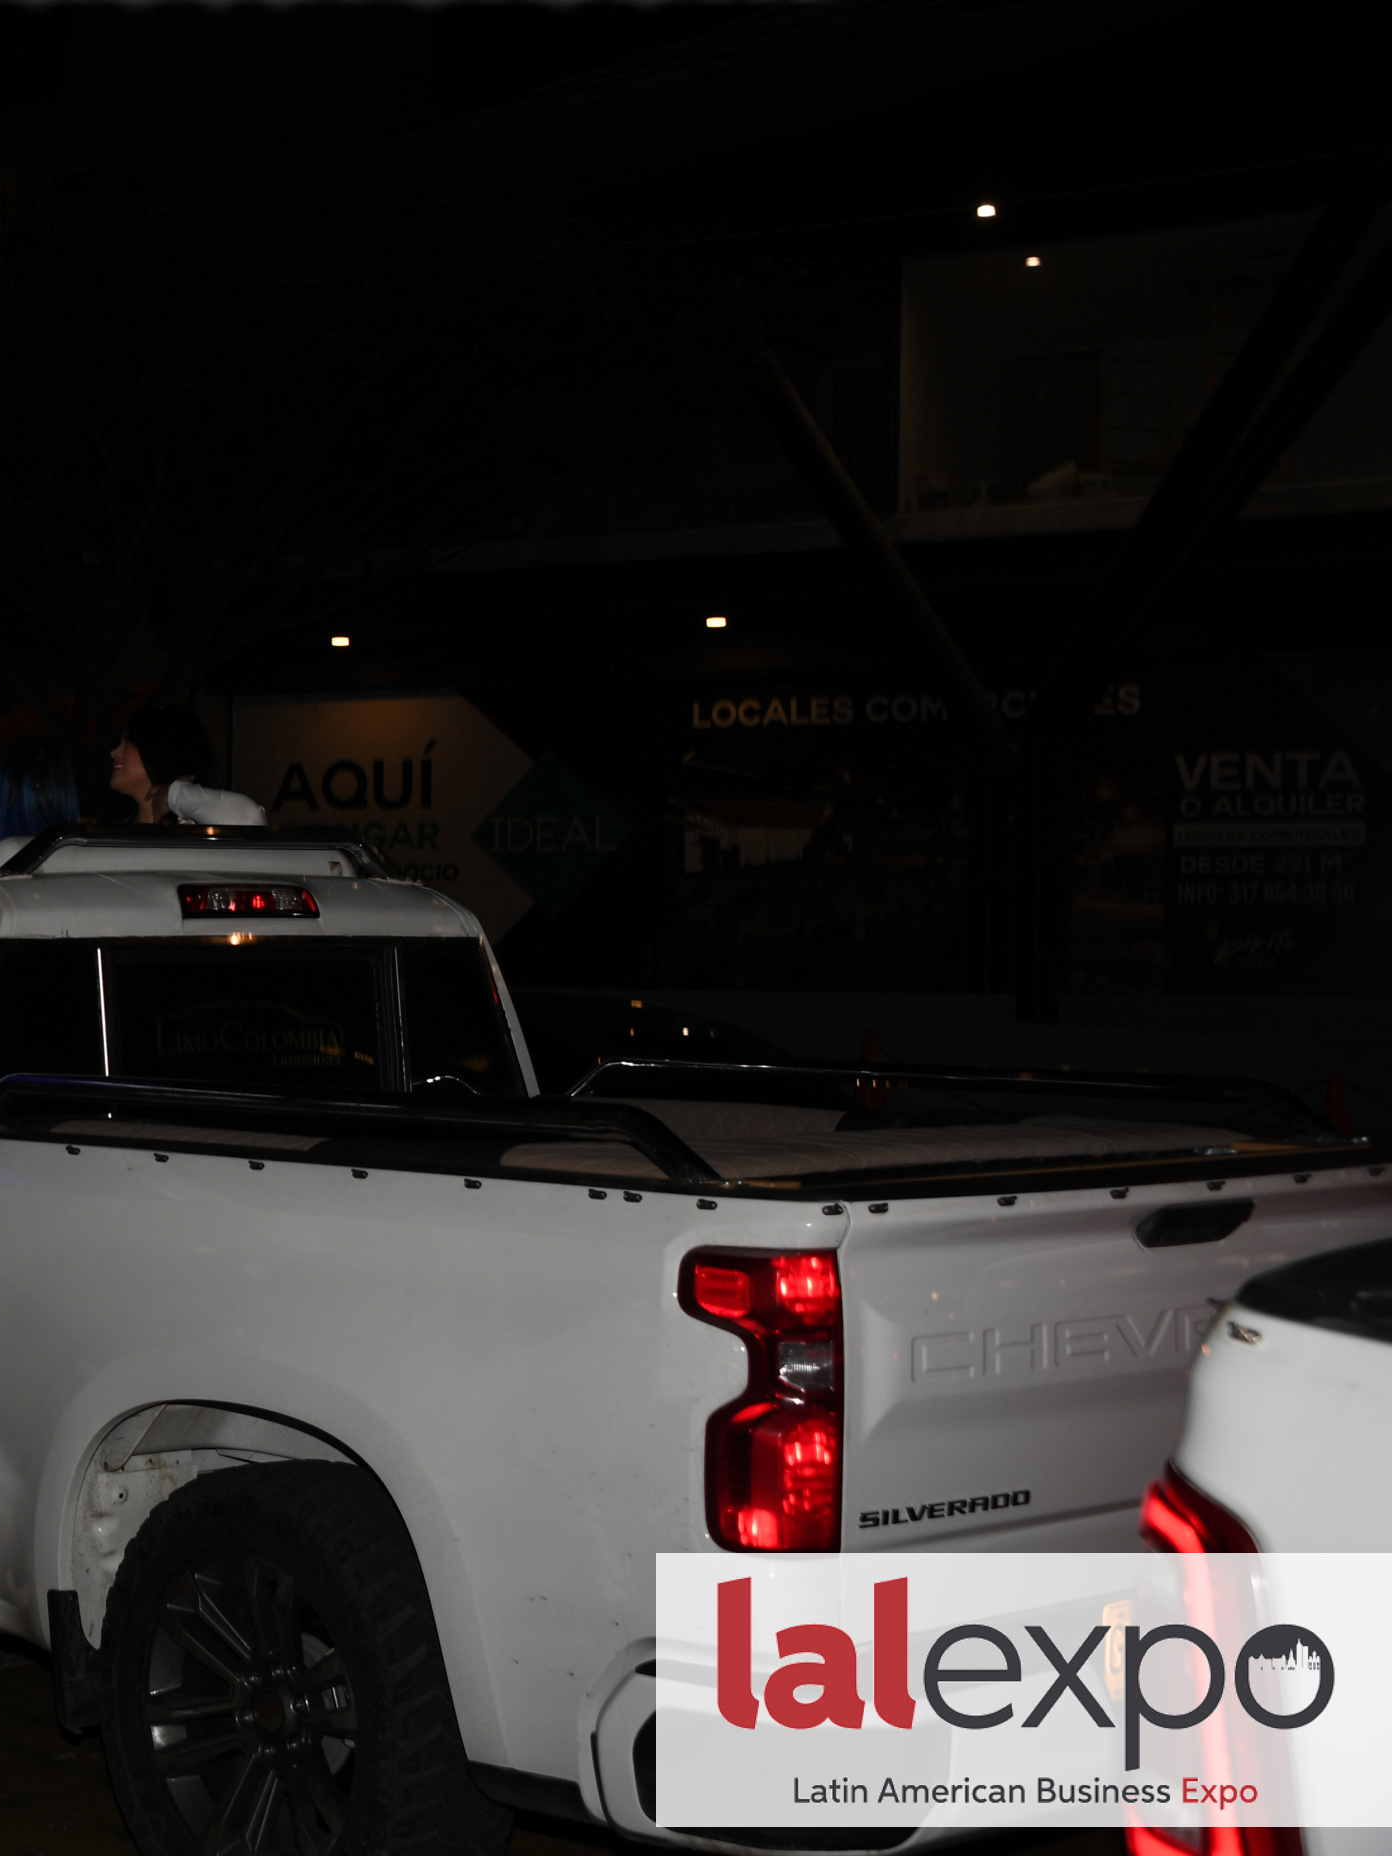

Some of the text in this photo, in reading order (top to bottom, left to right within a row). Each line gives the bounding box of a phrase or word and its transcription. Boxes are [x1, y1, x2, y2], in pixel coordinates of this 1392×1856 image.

[691, 694, 855, 729] LOCALES
[273, 739, 436, 811] AQUÍ
[1174, 749, 1363, 791] VENTA
[1179, 791, 1366, 818] O ALQUILER
[490, 816, 617, 853] IDEAL
[1177, 827, 1361, 843] LOCALES COMERCIALES
[1179, 854, 1265, 875] DESDE
[1274, 854, 1311, 874] 221
[1177, 881, 1223, 905] INFO:
[1229, 880, 1258, 904] 317
[859, 1490, 1030, 1528] SILVERADO
